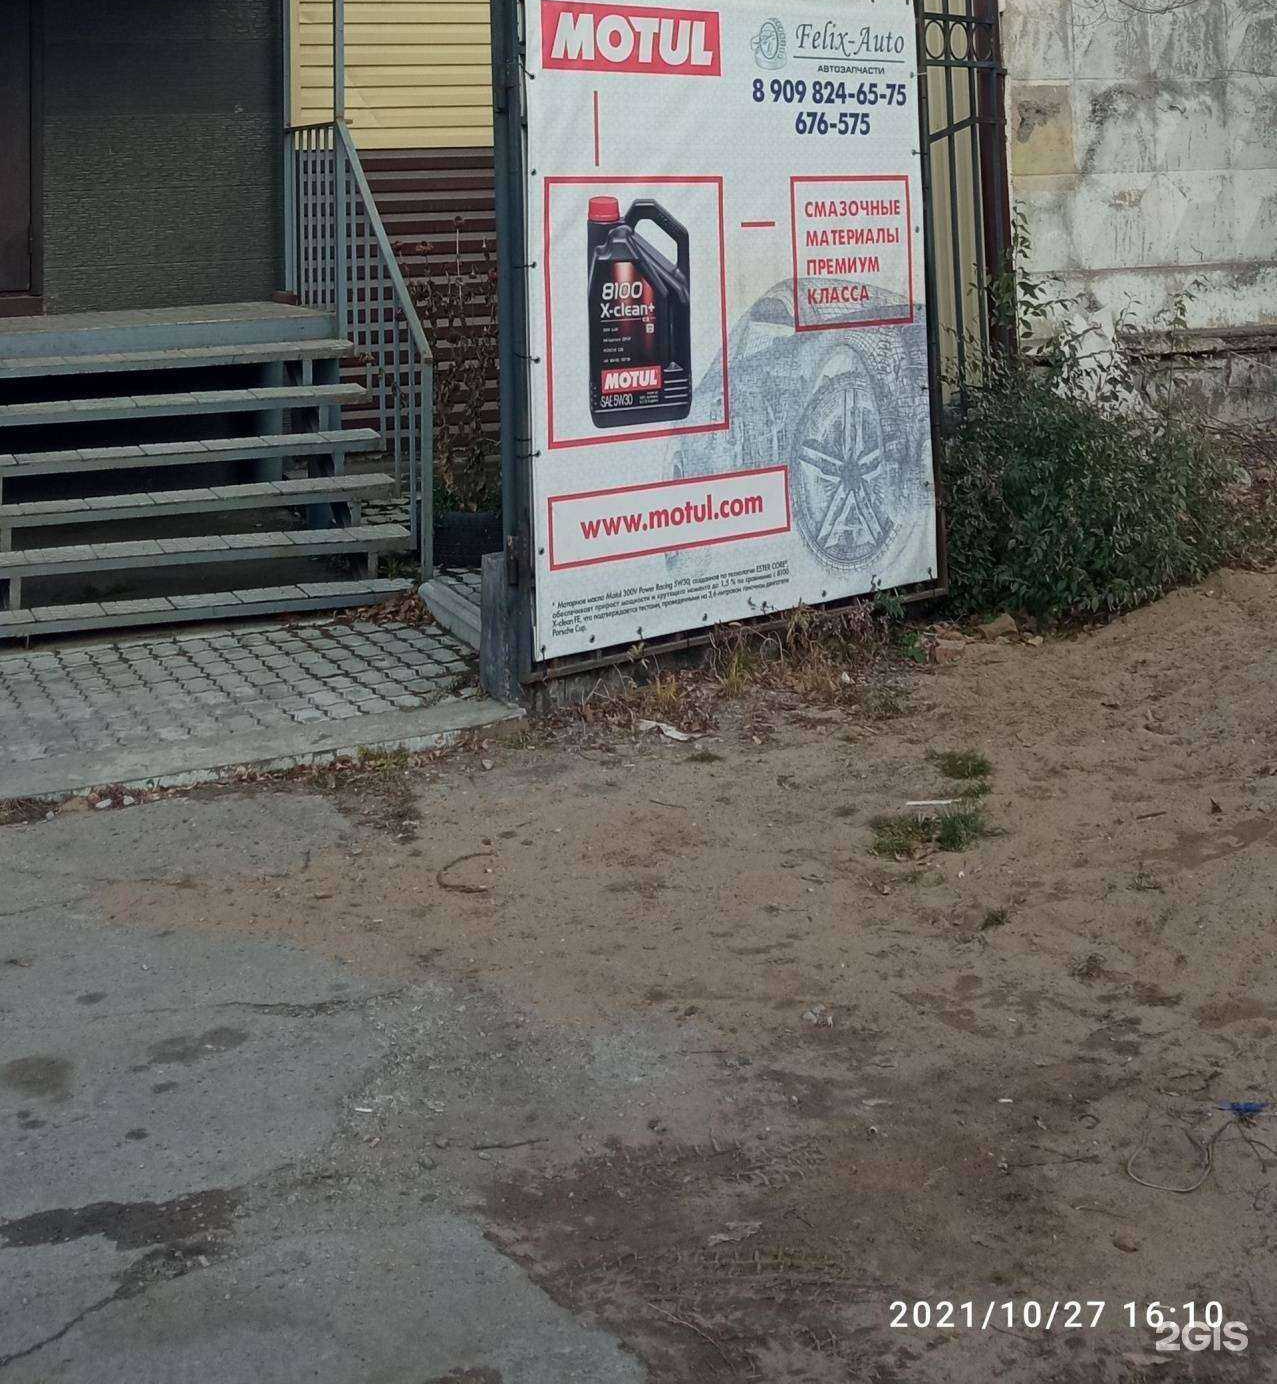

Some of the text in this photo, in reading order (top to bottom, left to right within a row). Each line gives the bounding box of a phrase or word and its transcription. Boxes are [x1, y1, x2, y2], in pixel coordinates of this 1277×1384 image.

[551, 12, 712, 66] MOTUL
[796, 21, 904, 57] Felix-Auto
[818, 65, 885, 75] АВТОЗАПЧАСТИ
[753, 78, 907, 106] 8 909 824-65-75
[795, 112, 870, 135] 676-575
[805, 200, 900, 217] СМАЗОЧНЫЕ
[805, 227, 900, 247] МАТЕРИАЛЫ
[806, 256, 880, 275] ПРЕМИУМ
[602, 281, 643, 300] 8100
[807, 289, 870, 305] КЛАССА
[604, 369, 658, 391] MOTUL
[600, 394, 614, 409] SAE
[614, 393, 634, 407] 5W30
[580, 494, 763, 539] www.motul.com
